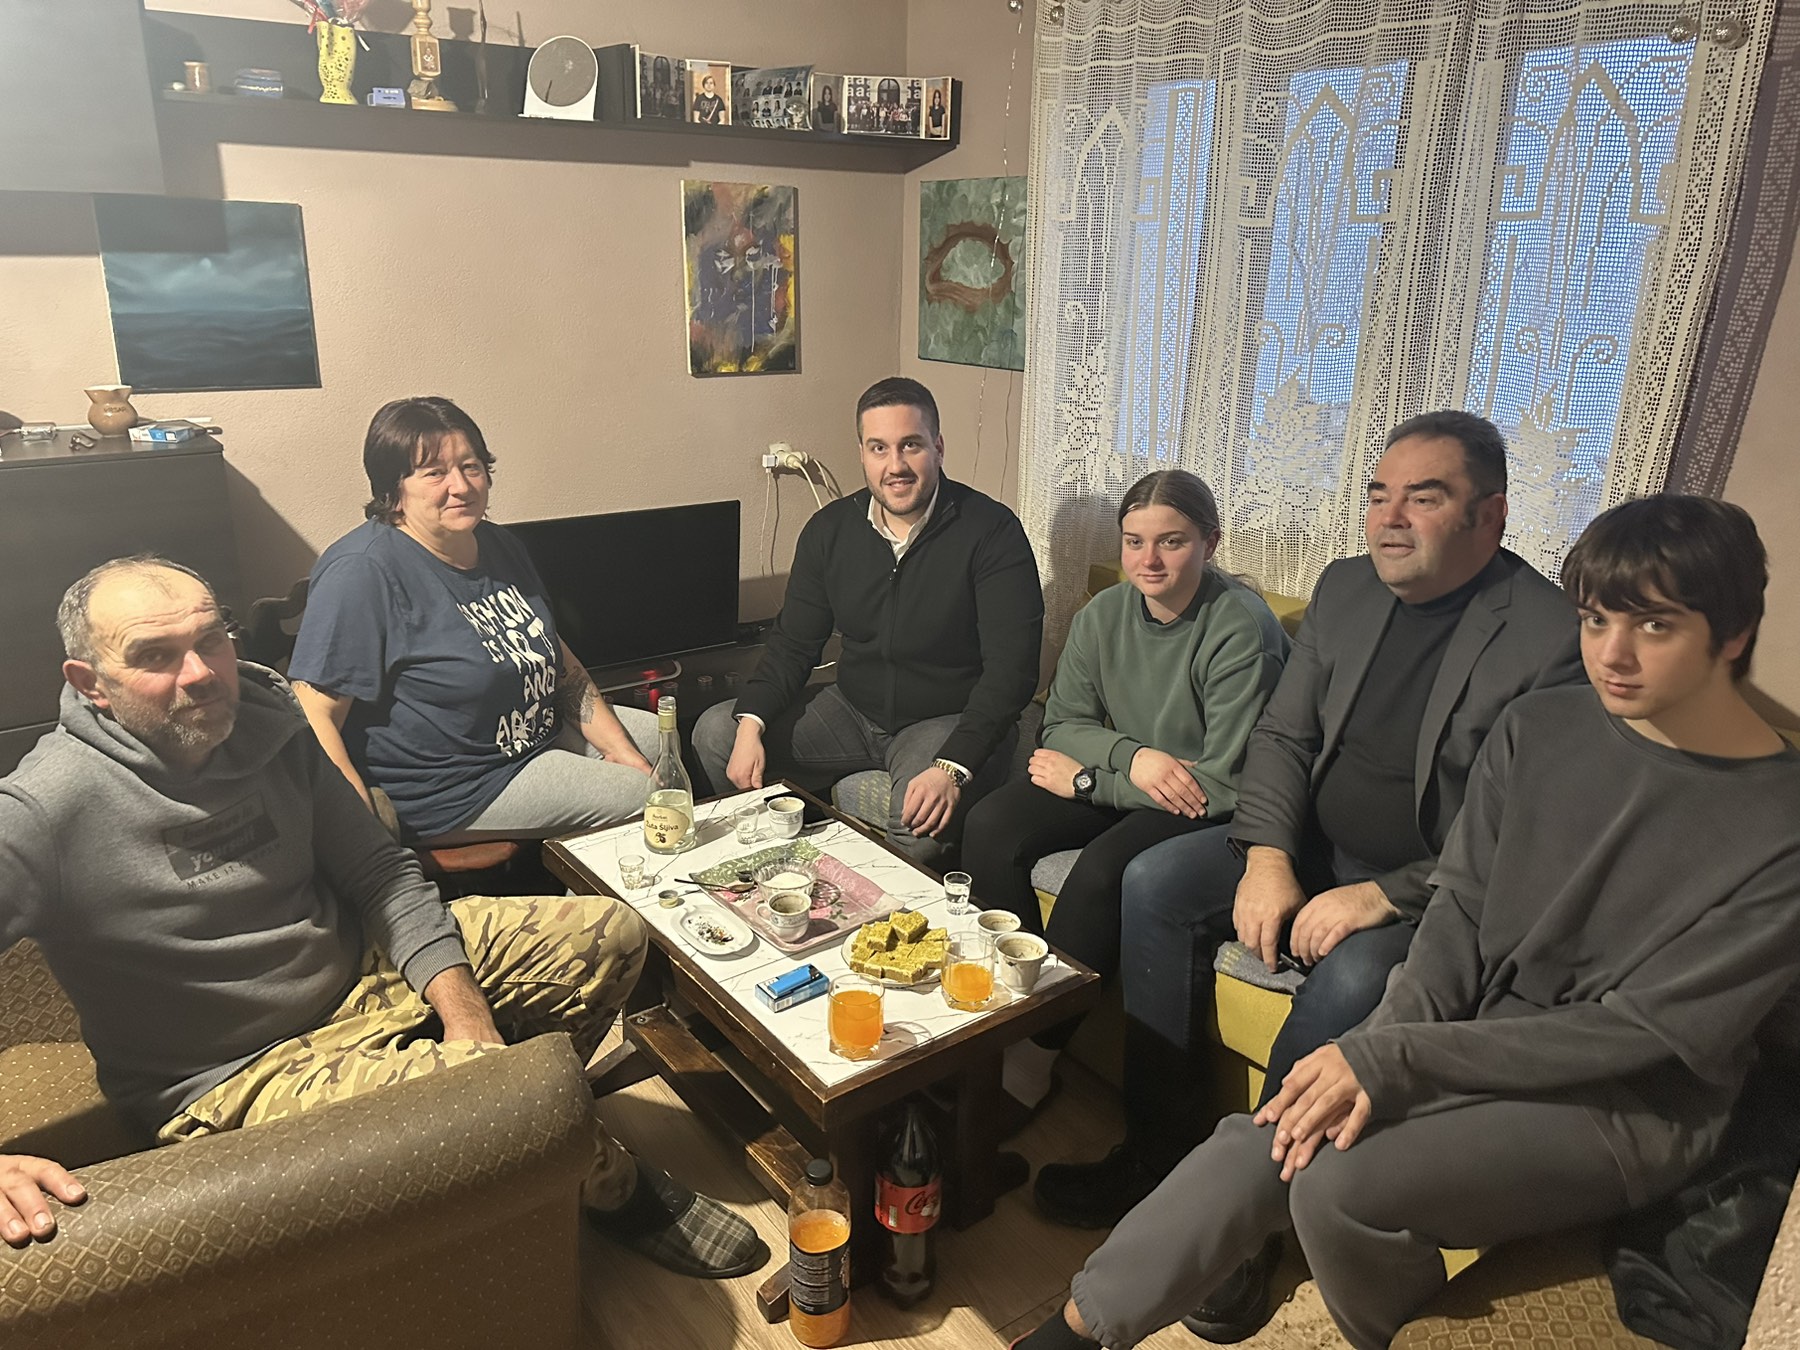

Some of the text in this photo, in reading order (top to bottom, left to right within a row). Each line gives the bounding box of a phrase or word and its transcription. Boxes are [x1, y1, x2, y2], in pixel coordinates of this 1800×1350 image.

[482, 616, 557, 676] IS ART
[523, 665, 557, 704] AND
